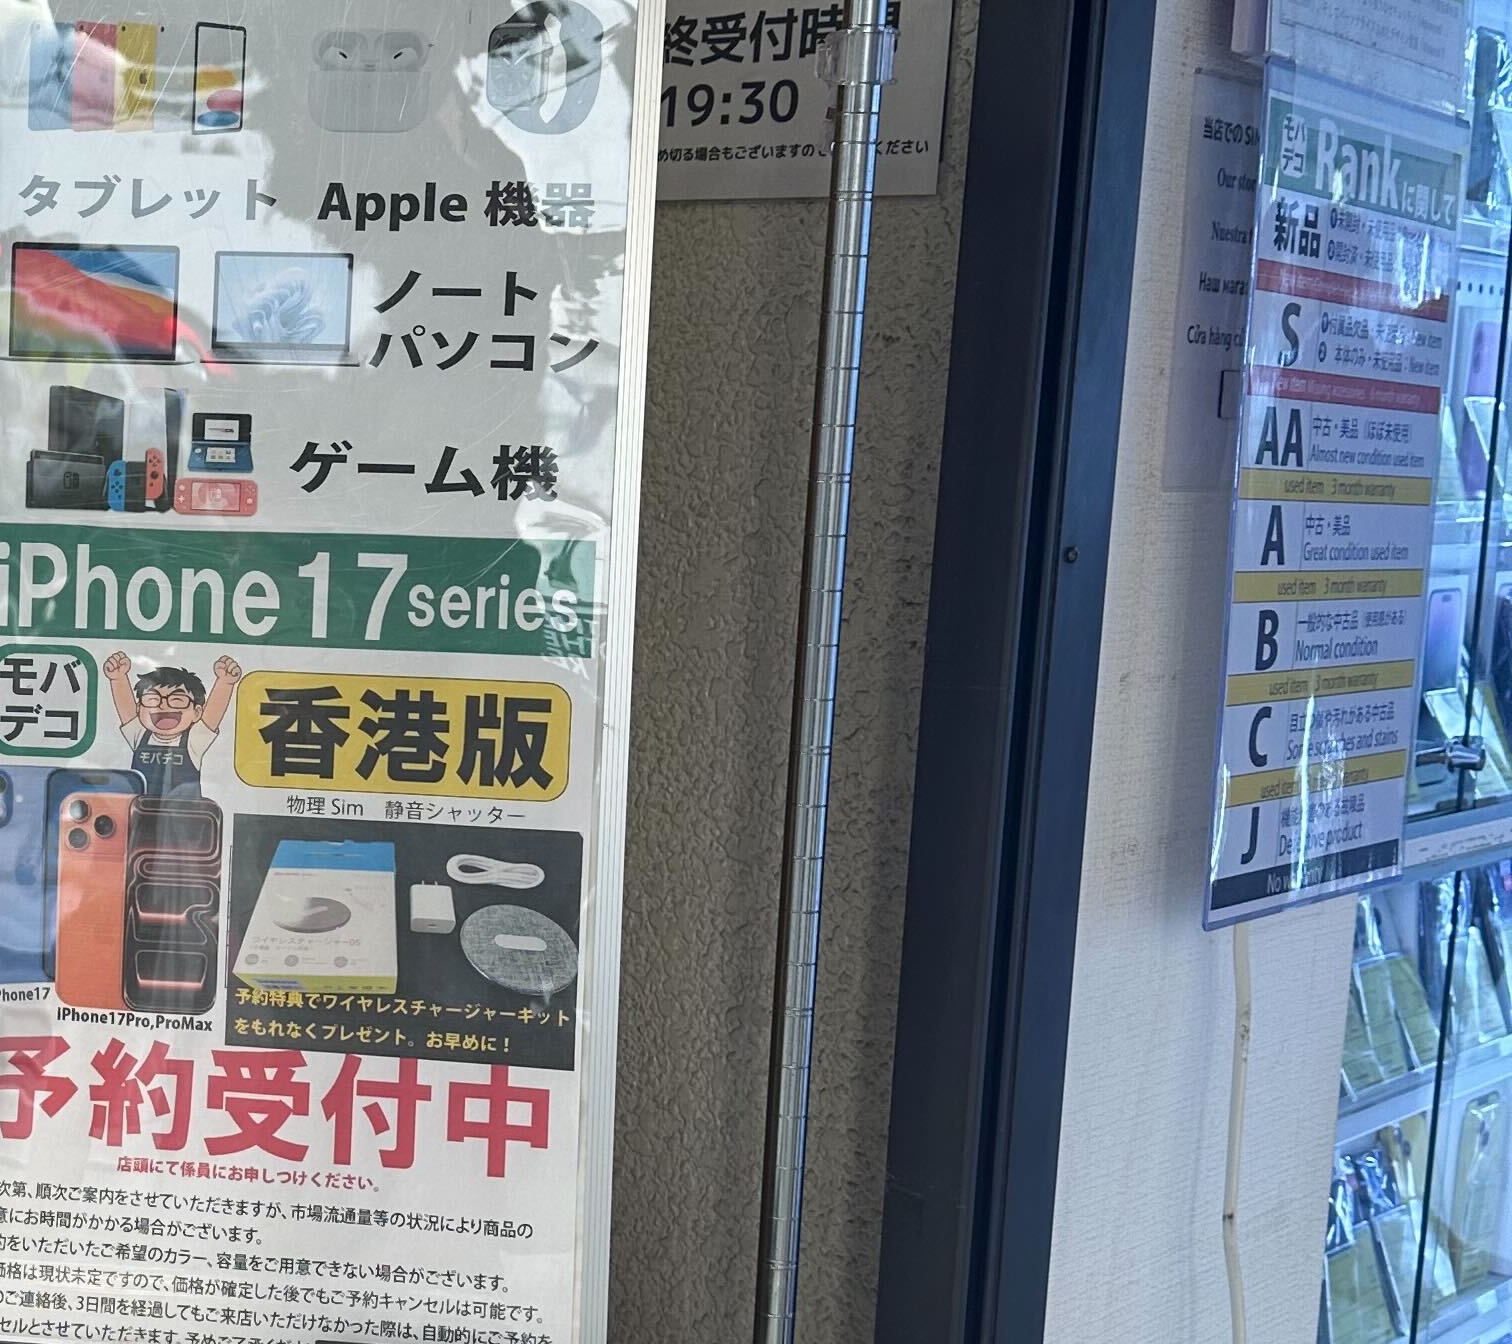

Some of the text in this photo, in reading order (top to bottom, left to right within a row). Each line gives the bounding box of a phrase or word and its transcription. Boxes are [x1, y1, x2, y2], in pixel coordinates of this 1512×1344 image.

[1217, 167, 1236, 189] Our
[1315, 117, 1402, 209] Rank
[19, 174, 595, 231] タブレット Apple 機器
[1273, 197, 1321, 258] 新品
[374, 270, 538, 316] ノート
[368, 325, 599, 373] パソコン
[1278, 302, 1301, 367] S
[1255, 407, 1303, 467] AA
[289, 441, 559, 502] ゲーム機
[1261, 505, 1285, 565] A
[1304, 543, 1327, 561] Great
[1329, 543, 1368, 560] condition
[298, 551, 408, 641] 17
[1256, 609, 1279, 671] B
[1296, 638, 1378, 662] Normal condition
[0, 657, 81, 696] モバ
[0, 704, 79, 741] デコ
[258, 685, 555, 790] 香港版
[1249, 706, 1272, 767] C
[287, 795, 526, 824] 物理 Sim 静音シャッター
[1241, 806, 1259, 865] J
[57, 1007, 213, 1032] iPhone17Pro,ProMax
[234, 986, 571, 1029] 予約特典でワイヤレスチャージャーキット
[117, 1156, 384, 1193] 店頭にて係員にお申しつけください。
